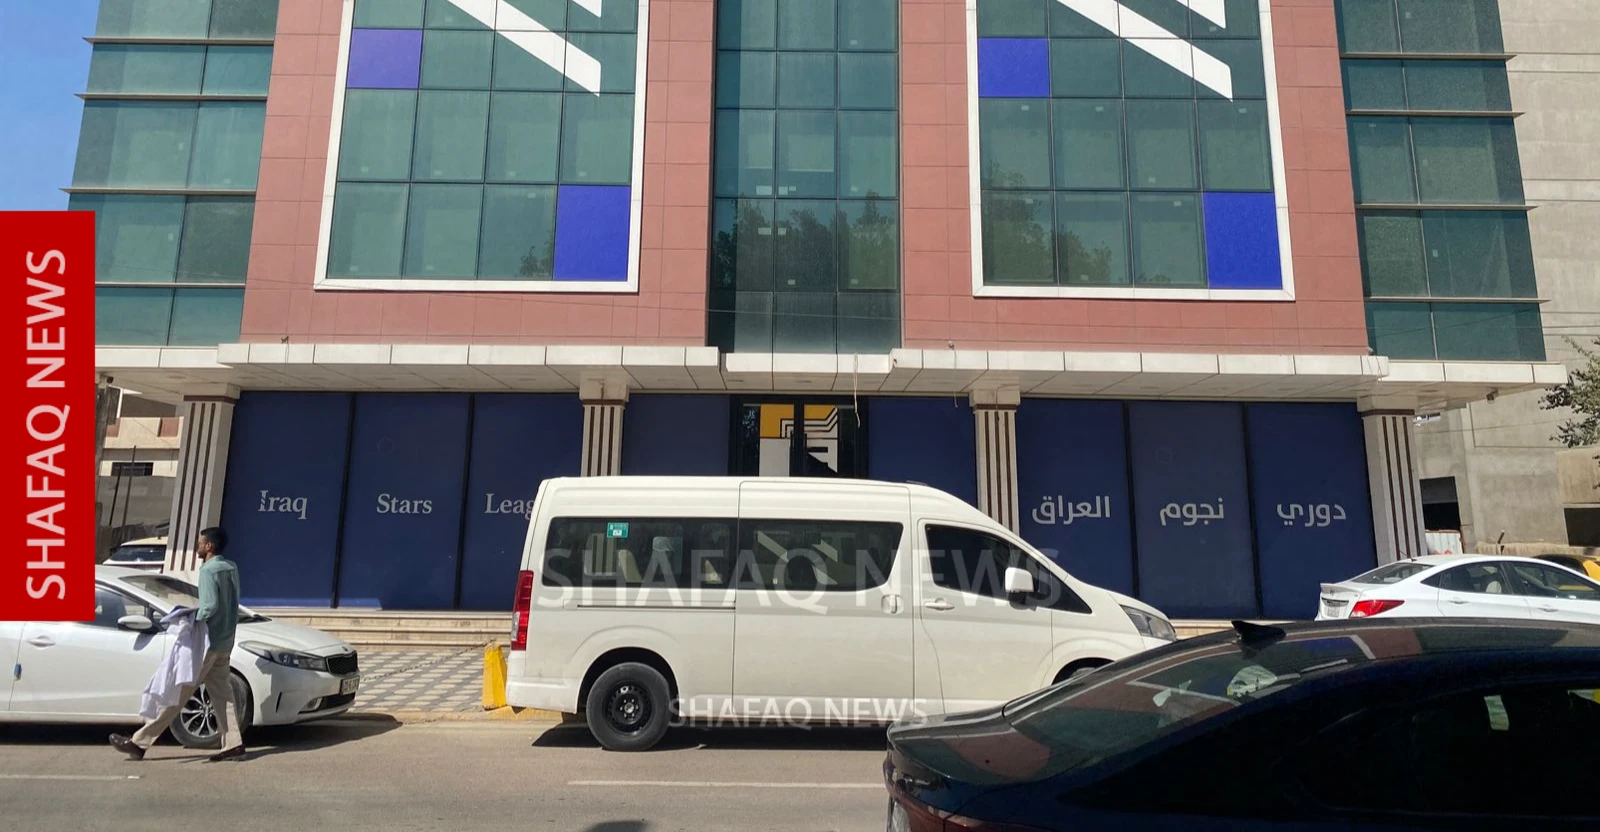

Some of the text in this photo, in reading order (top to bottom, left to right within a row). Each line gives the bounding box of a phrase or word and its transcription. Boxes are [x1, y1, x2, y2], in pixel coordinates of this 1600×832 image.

[257, 490, 535, 521] Iraq Stars Leag
[1031, 495, 1347, 528] دوري نجوم العراق
